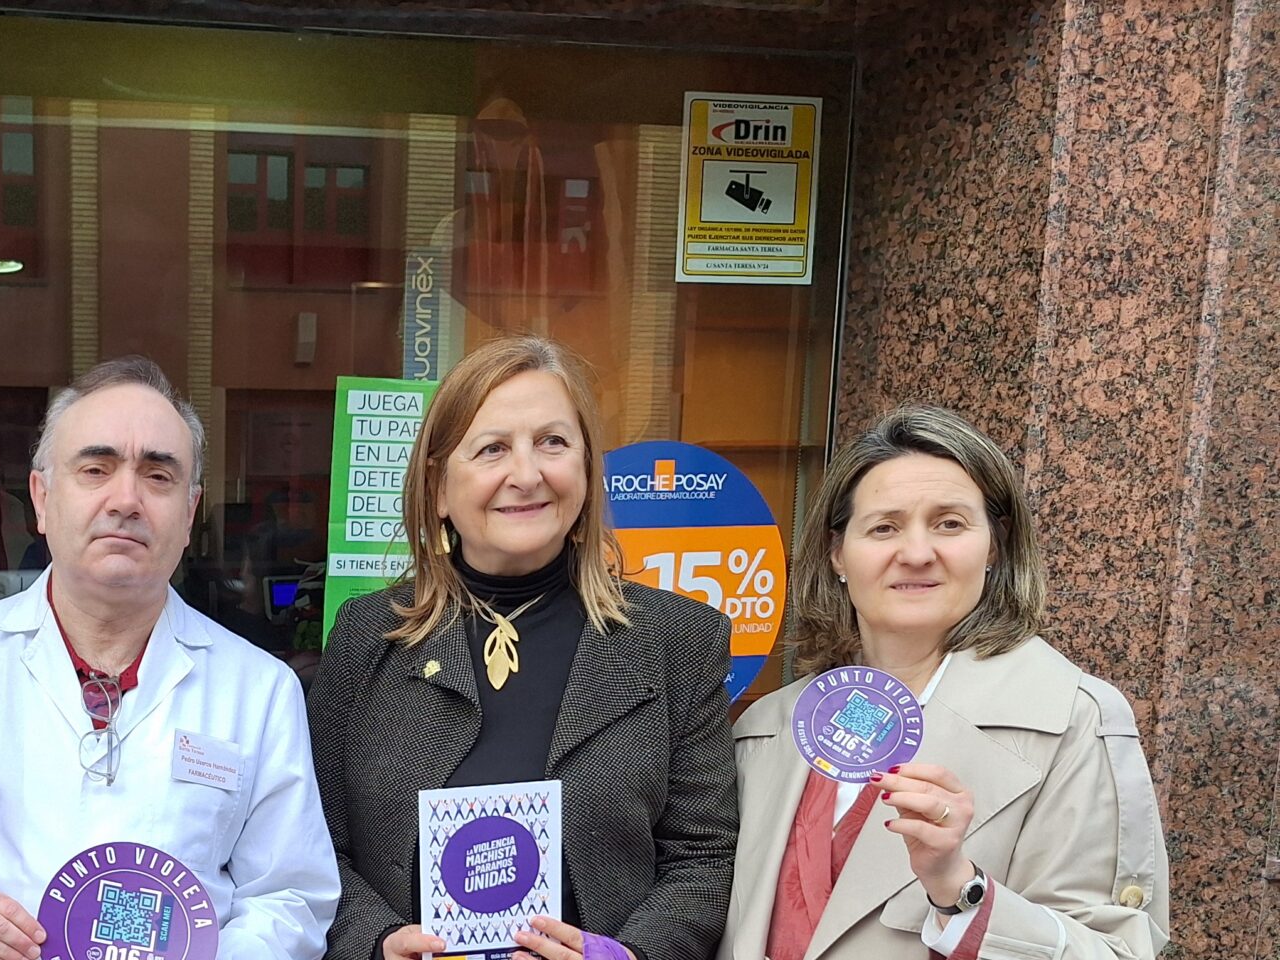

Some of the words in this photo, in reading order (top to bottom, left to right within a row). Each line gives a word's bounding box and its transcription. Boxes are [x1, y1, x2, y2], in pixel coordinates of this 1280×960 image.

[712, 102, 789, 110] VIDEOVIGILANCIA
[734, 119, 787, 142] Drin
[692, 146, 722, 156] ZONA
[726, 147, 810, 160] VIDEOVIGILADA
[358, 394, 419, 412] JUEGA
[356, 419, 382, 437] TU
[355, 446, 380, 462] EN
[612, 474, 670, 492] ROCHE
[673, 474, 728, 490] POSAY
[351, 496, 387, 513] DEL
[350, 521, 374, 538] DE
[336, 560, 346, 570] SI
[349, 560, 387, 571] TIENES
[726, 596, 774, 619] DTO
[816, 670, 874, 692] PUNTO
[884, 680, 920, 746] VIOLETA
[832, 729, 859, 751] 016
[188, 768, 226, 783] FARMACÉUTICO
[473, 836, 516, 854] VIOLENCIA
[466, 844, 518, 868] MACHISTA
[475, 858, 514, 874] PARAMOS
[49, 846, 116, 902] PUNTO
[135, 847, 212, 928] VIOLETA
[464, 866, 516, 893] UNIDAS
[160, 920, 169, 941] SCAN
